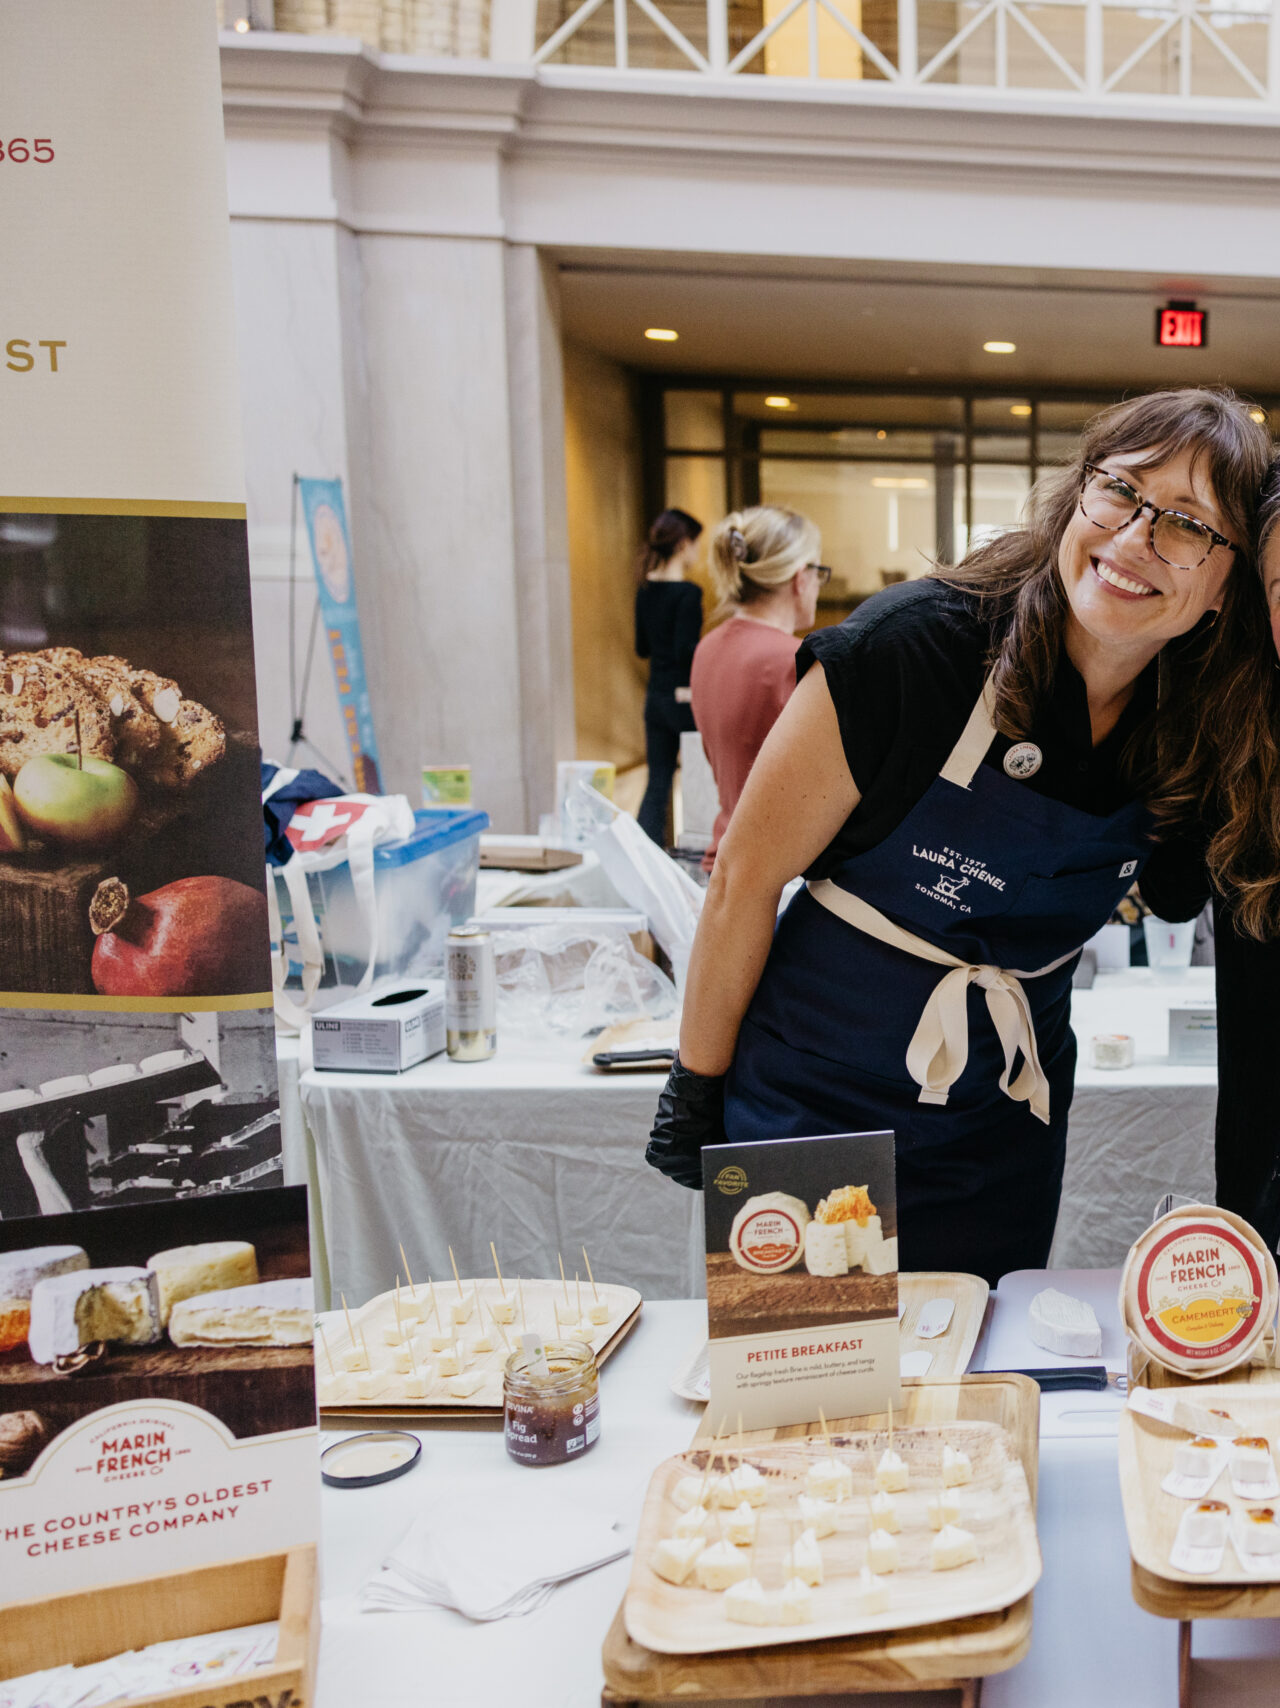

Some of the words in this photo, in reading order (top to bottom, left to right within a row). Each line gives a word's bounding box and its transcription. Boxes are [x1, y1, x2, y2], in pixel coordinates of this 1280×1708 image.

[0, 138, 55, 163] 65
[1161, 310, 1203, 346] EXIT
[912, 844, 955, 870] LAURA
[959, 863, 1007, 892] CHENEL
[943, 846, 962, 860] EST.
[965, 857, 987, 869] 1979
[915, 883, 957, 910] SONOMA,
[959, 904, 972, 913] CA
[713, 1179, 750, 1190] FAVORITE
[725, 1173, 739, 1181] FAN
[754, 1227, 783, 1236] FRENCH
[1172, 1247, 1220, 1267] MARIN
[1170, 1262, 1226, 1284] FRENCH
[1177, 1282, 1209, 1292] CHEESE
[1172, 1307, 1235, 1324] CAMEMBERT
[747, 1348, 788, 1363] PETITE
[791, 1339, 864, 1358] BREAKFAST
[139, 1418, 175, 1431] ORIGINAL
[512, 1420, 527, 1434] Fig
[102, 1431, 165, 1455] MARIN
[96, 1448, 171, 1474] FRENCH
[104, 1470, 146, 1482] CHEESE
[0, 1523, 35, 1541] HE
[44, 1497, 178, 1534] COUNTRY'S
[185, 1479, 273, 1507] OLDEST
[27, 1527, 121, 1557] CHEESE
[129, 1506, 240, 1537] COMPANY
